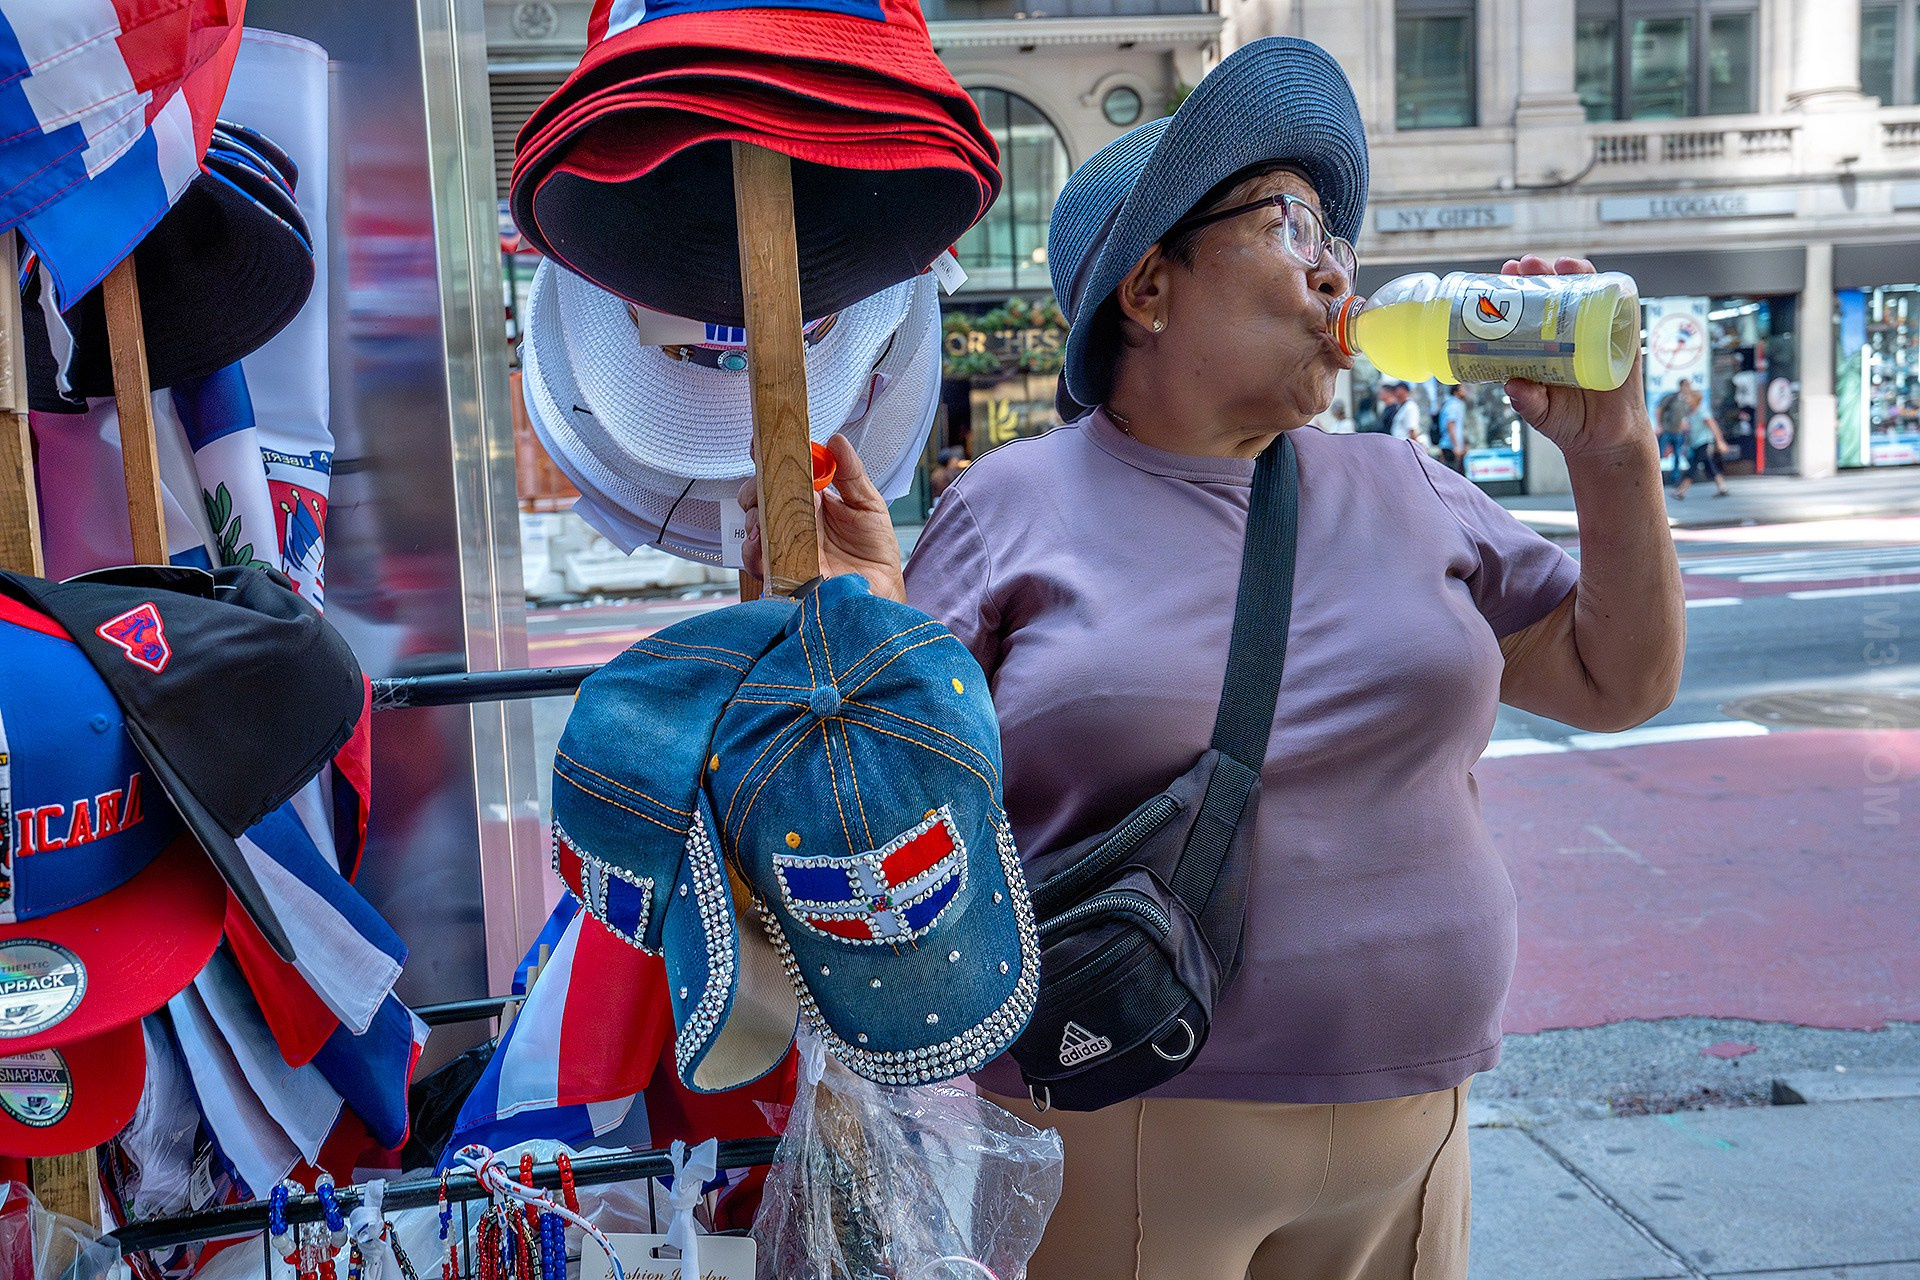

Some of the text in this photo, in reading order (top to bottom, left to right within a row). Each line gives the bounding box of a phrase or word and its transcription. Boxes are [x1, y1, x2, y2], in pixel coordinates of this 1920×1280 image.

[1397, 205, 1495, 229] NY GIFTS
[1649, 196, 1746, 217] LUGGAGE
[1061, 1039, 1108, 1064] adidas
[0, 1068, 60, 1082] SNAPBACK
